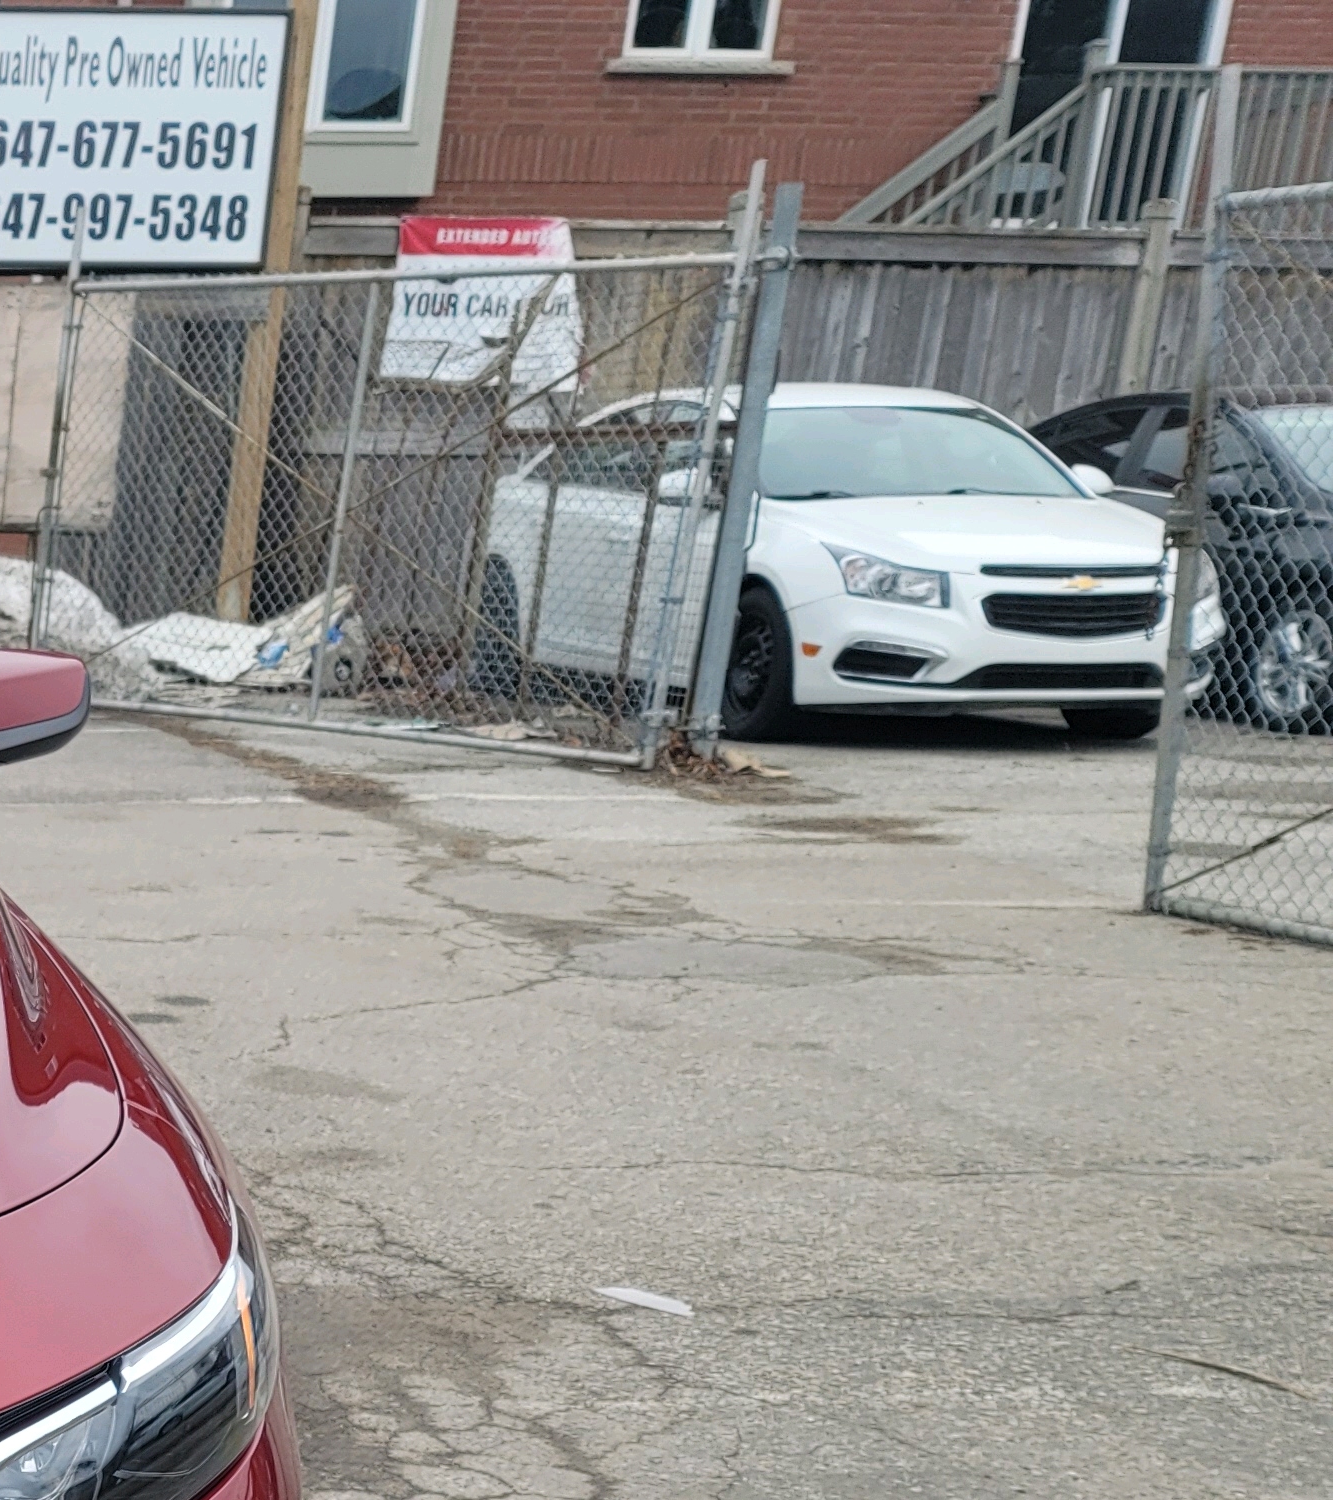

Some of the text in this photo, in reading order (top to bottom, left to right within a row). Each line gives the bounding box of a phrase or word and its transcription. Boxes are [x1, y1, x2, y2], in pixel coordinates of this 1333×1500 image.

[63, 35, 101, 88] Pre
[107, 36, 185, 88] Owned
[192, 36, 268, 89] Vehicle
[435, 227, 511, 245] EXTENDED
[403, 292, 508, 319] YOUR CAR
